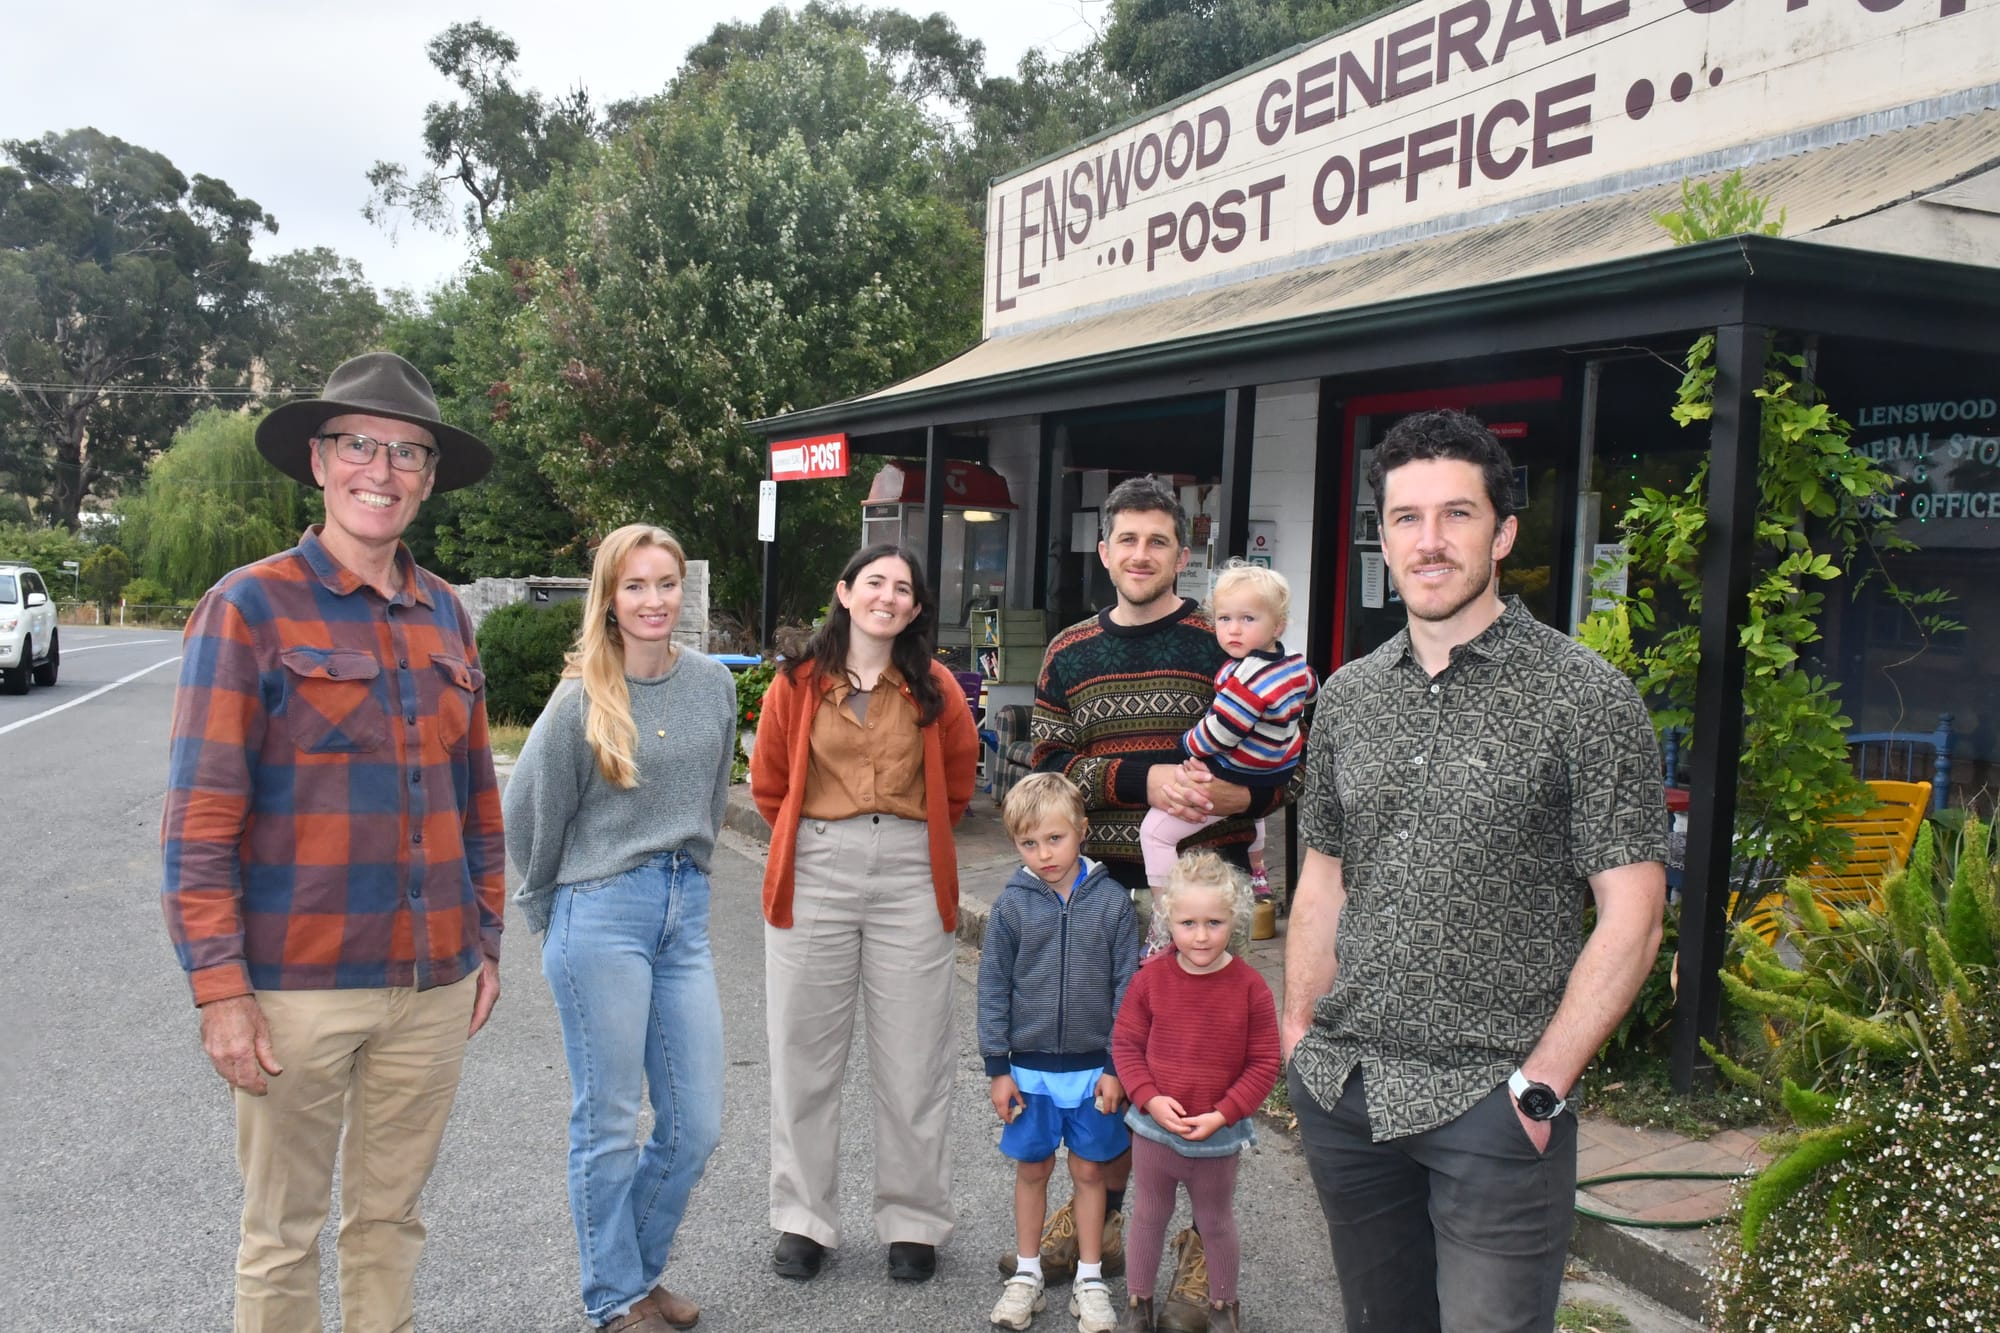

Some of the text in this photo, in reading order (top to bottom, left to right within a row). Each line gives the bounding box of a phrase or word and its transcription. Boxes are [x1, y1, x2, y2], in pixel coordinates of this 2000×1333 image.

[996, 0, 1631, 312] LENSWOOD GENERAL
[1313, 73, 1596, 226] OFFICE
[1858, 399, 1997, 427] LENSWOOD
[810, 441, 841, 472] POST
[1947, 433, 2000, 468] STO
[1911, 492, 2000, 518] OFFICE
